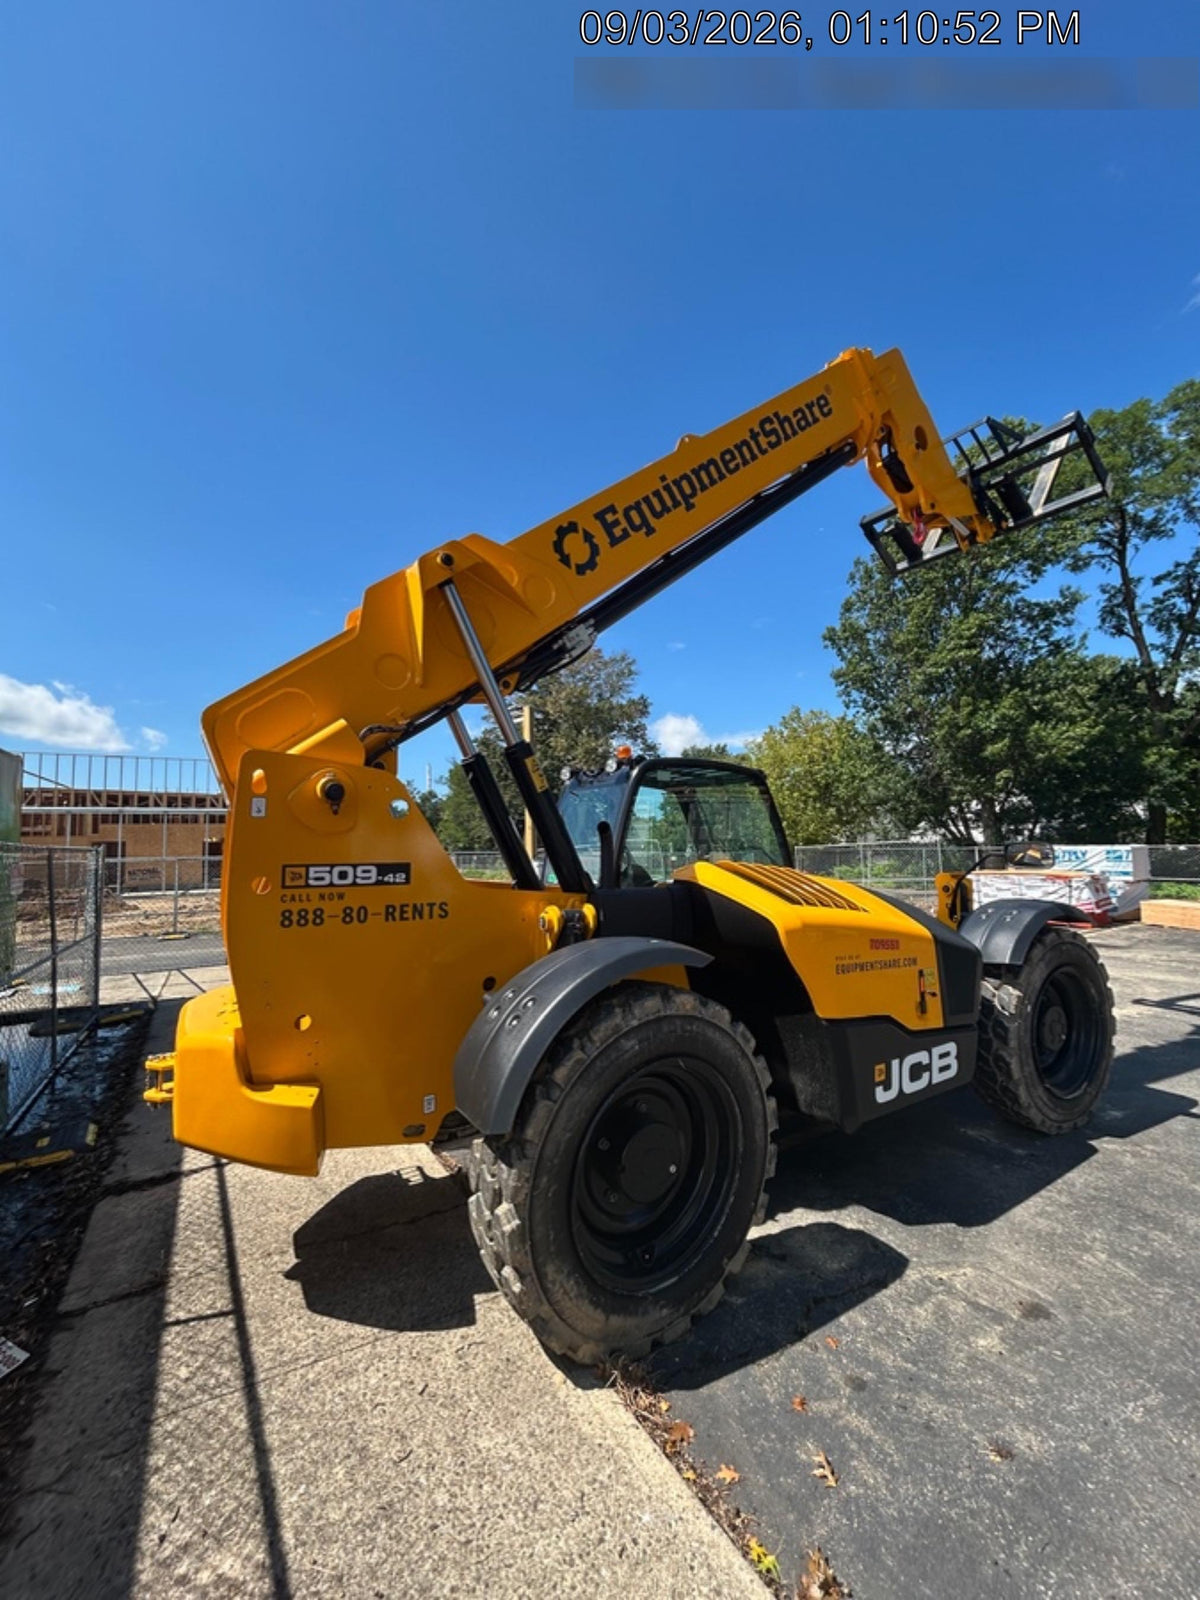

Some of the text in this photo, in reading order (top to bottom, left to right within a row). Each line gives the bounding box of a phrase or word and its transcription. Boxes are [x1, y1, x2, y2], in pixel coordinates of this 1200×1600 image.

[593, 393, 833, 548] EquipmentShare
[307, 865, 406, 885] 509-42
[280, 892, 346, 903] CALL NOW
[279, 902, 449, 928] 888-80-RENTS
[835, 956, 918, 975] EQUIPMENTSHARE.COM
[875, 1041, 959, 1103] JCB
